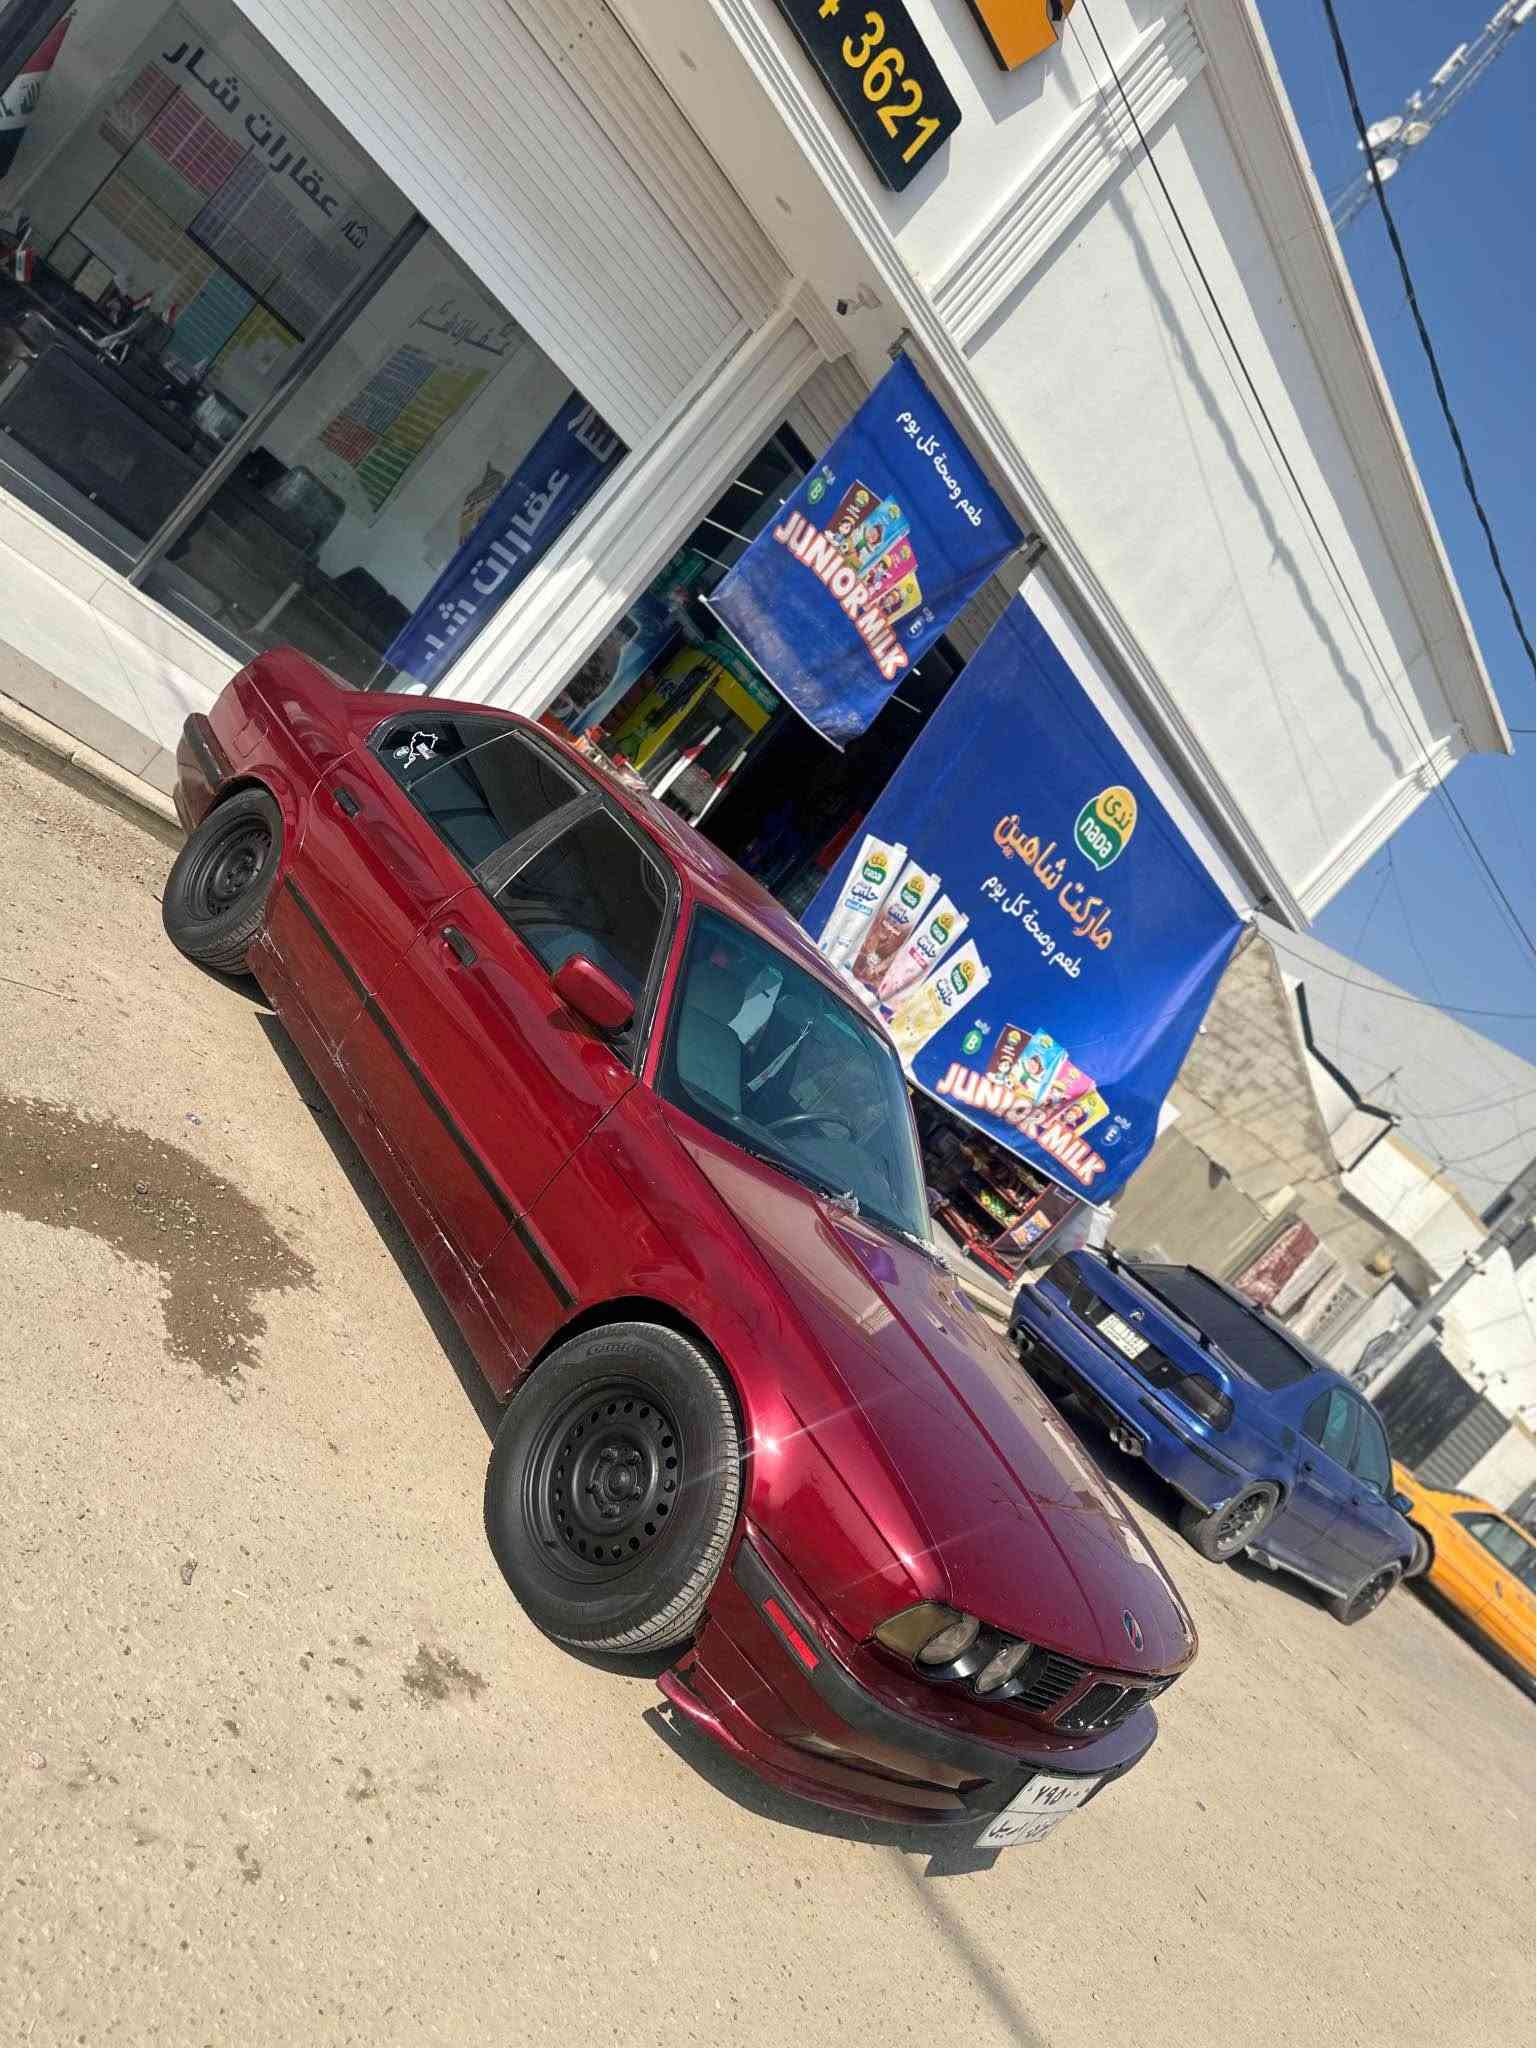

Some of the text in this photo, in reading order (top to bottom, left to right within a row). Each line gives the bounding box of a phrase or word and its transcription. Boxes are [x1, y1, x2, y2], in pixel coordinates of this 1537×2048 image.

[162, 42, 240, 113] شار
[843, 11, 941, 163] 3621
[244, 113, 338, 217] عقارات
[896, 411, 982, 527] طعم وصحة كل يوم
[471, 469, 570, 595] عقارات
[773, 511, 909, 681] JUNIOR MILK
[1103, 795, 1133, 831] ندى
[980, 876, 1081, 978] طعم وصحة كل يوم
[993, 815, 1113, 950] ماركت شاهين
[936, 1062, 1106, 1185] JUNIOR MILK
